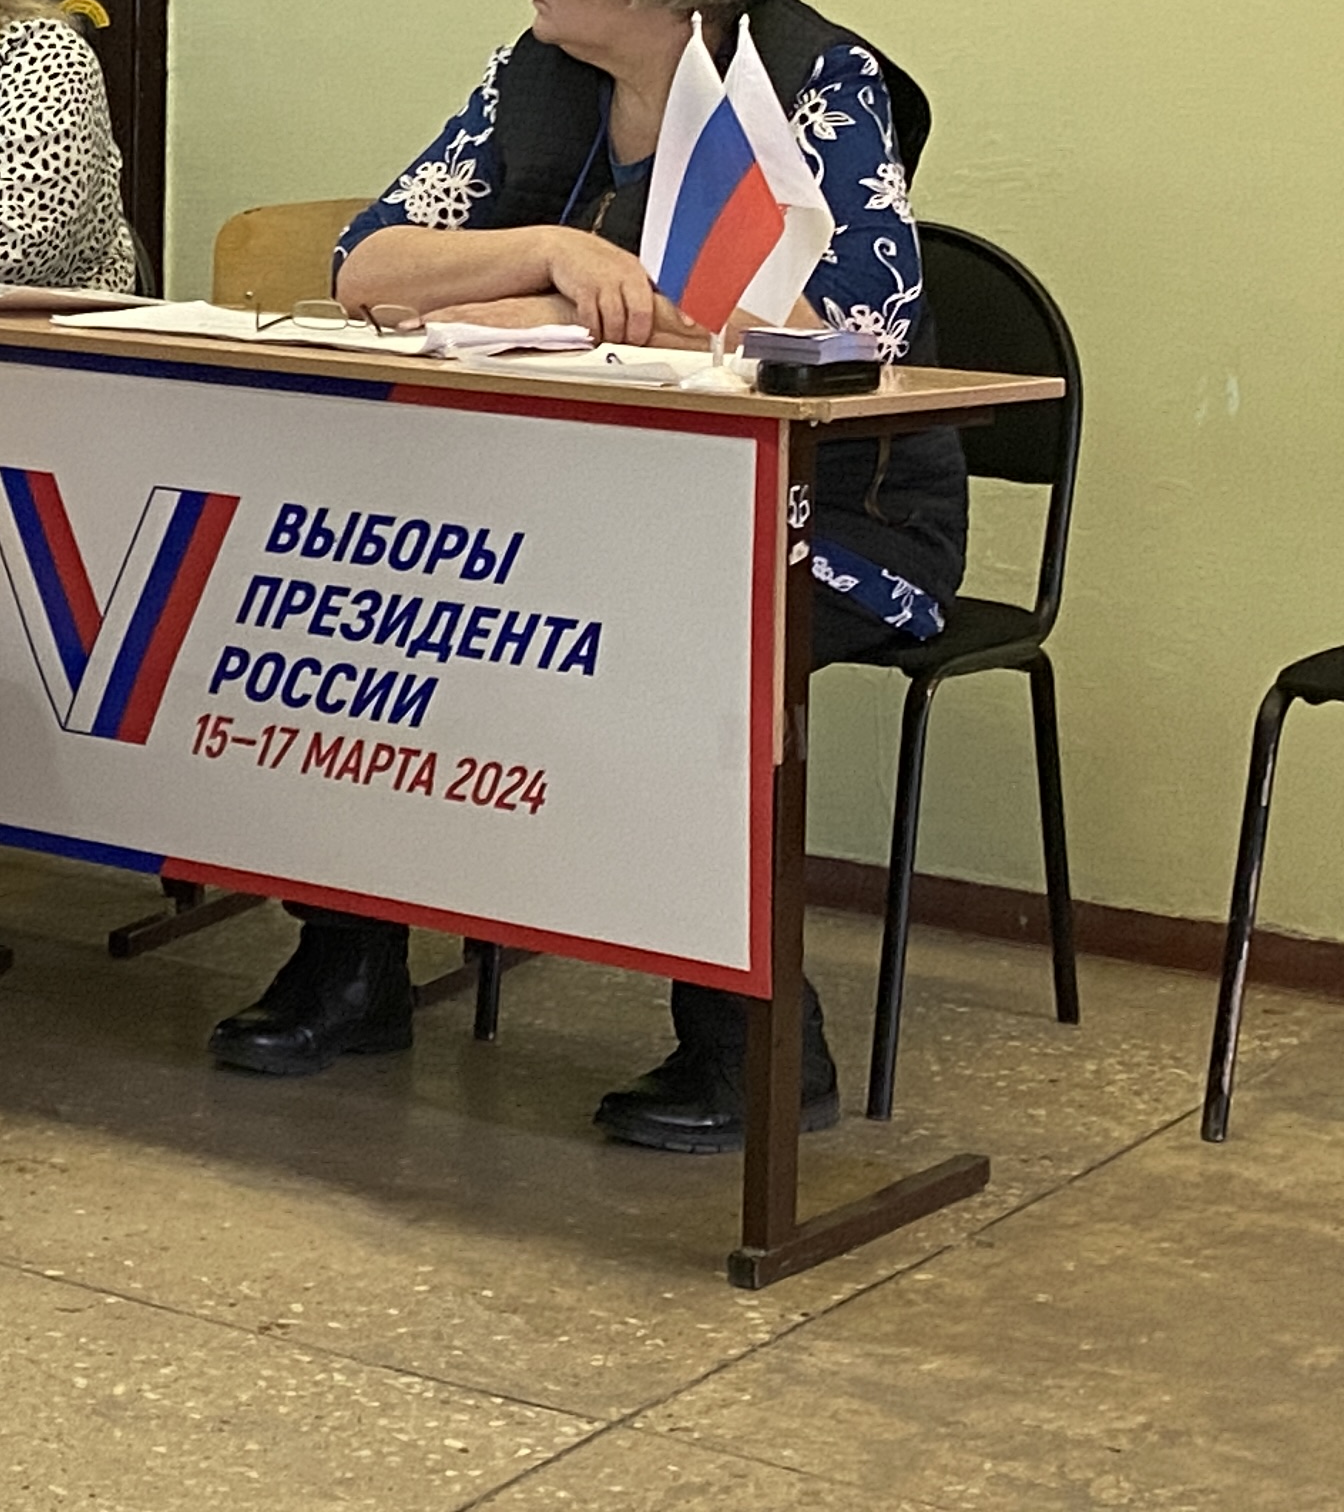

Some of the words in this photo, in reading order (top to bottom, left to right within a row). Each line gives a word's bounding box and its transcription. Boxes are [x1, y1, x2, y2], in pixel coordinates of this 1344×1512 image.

[265, 502, 526, 585] ВЫБОРЫ
[235, 574, 603, 676] ПРЕЗИДЕНТА
[208, 645, 440, 728] РОССИИ
[300, 732, 438, 797] МАРТА
[444, 756, 548, 815] 2024
